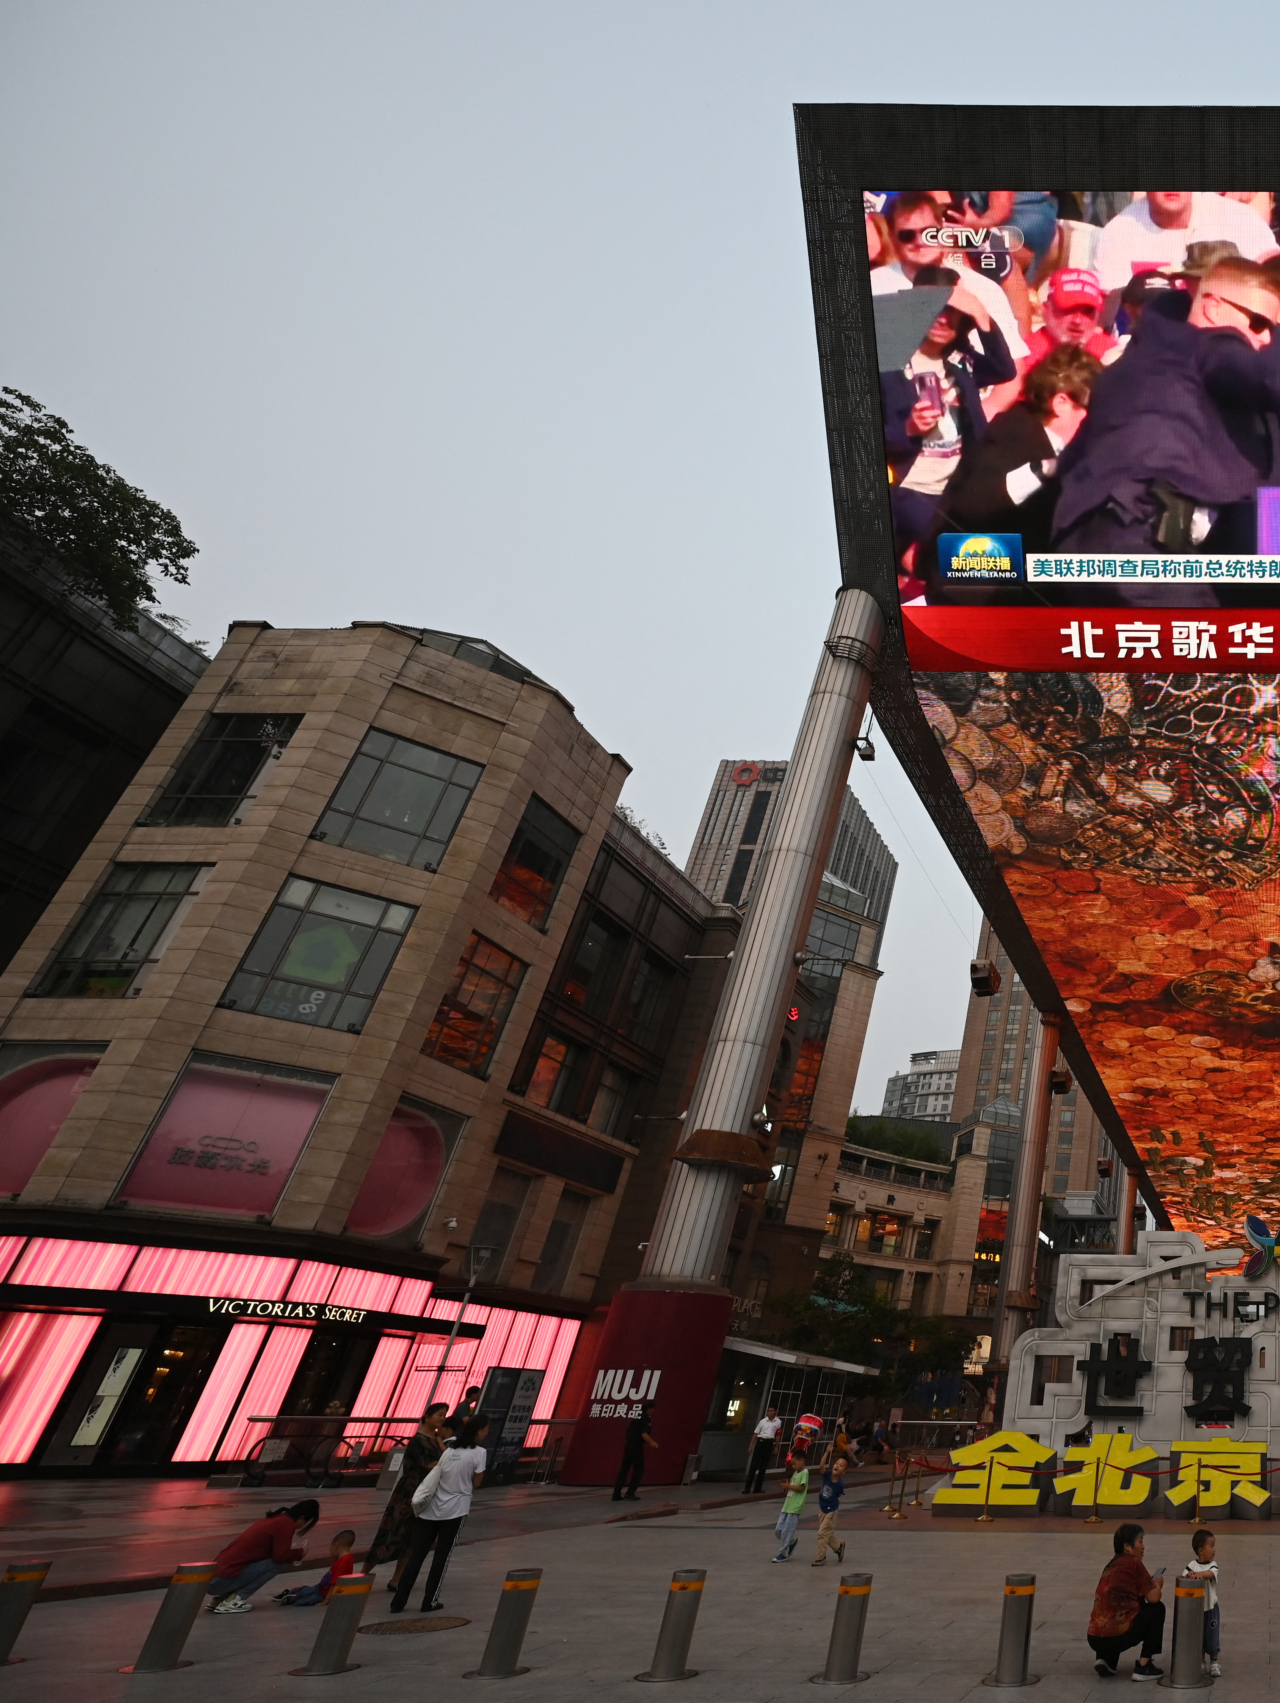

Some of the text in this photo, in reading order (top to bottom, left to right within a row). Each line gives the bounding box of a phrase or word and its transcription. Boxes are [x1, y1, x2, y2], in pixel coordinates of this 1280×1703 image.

[921, 227, 1010, 249] CCTV 1
[947, 253, 996, 269] 综合
[951, 556, 1011, 571] 新闻联播
[946, 571, 983, 579] XINWEN
[208, 1298, 367, 1323] VICTORIA'S SECRET
[1183, 1291, 1250, 1319] THE
[590, 1369, 662, 1401] MUJI
[589, 1402, 643, 1420] 無印良品
